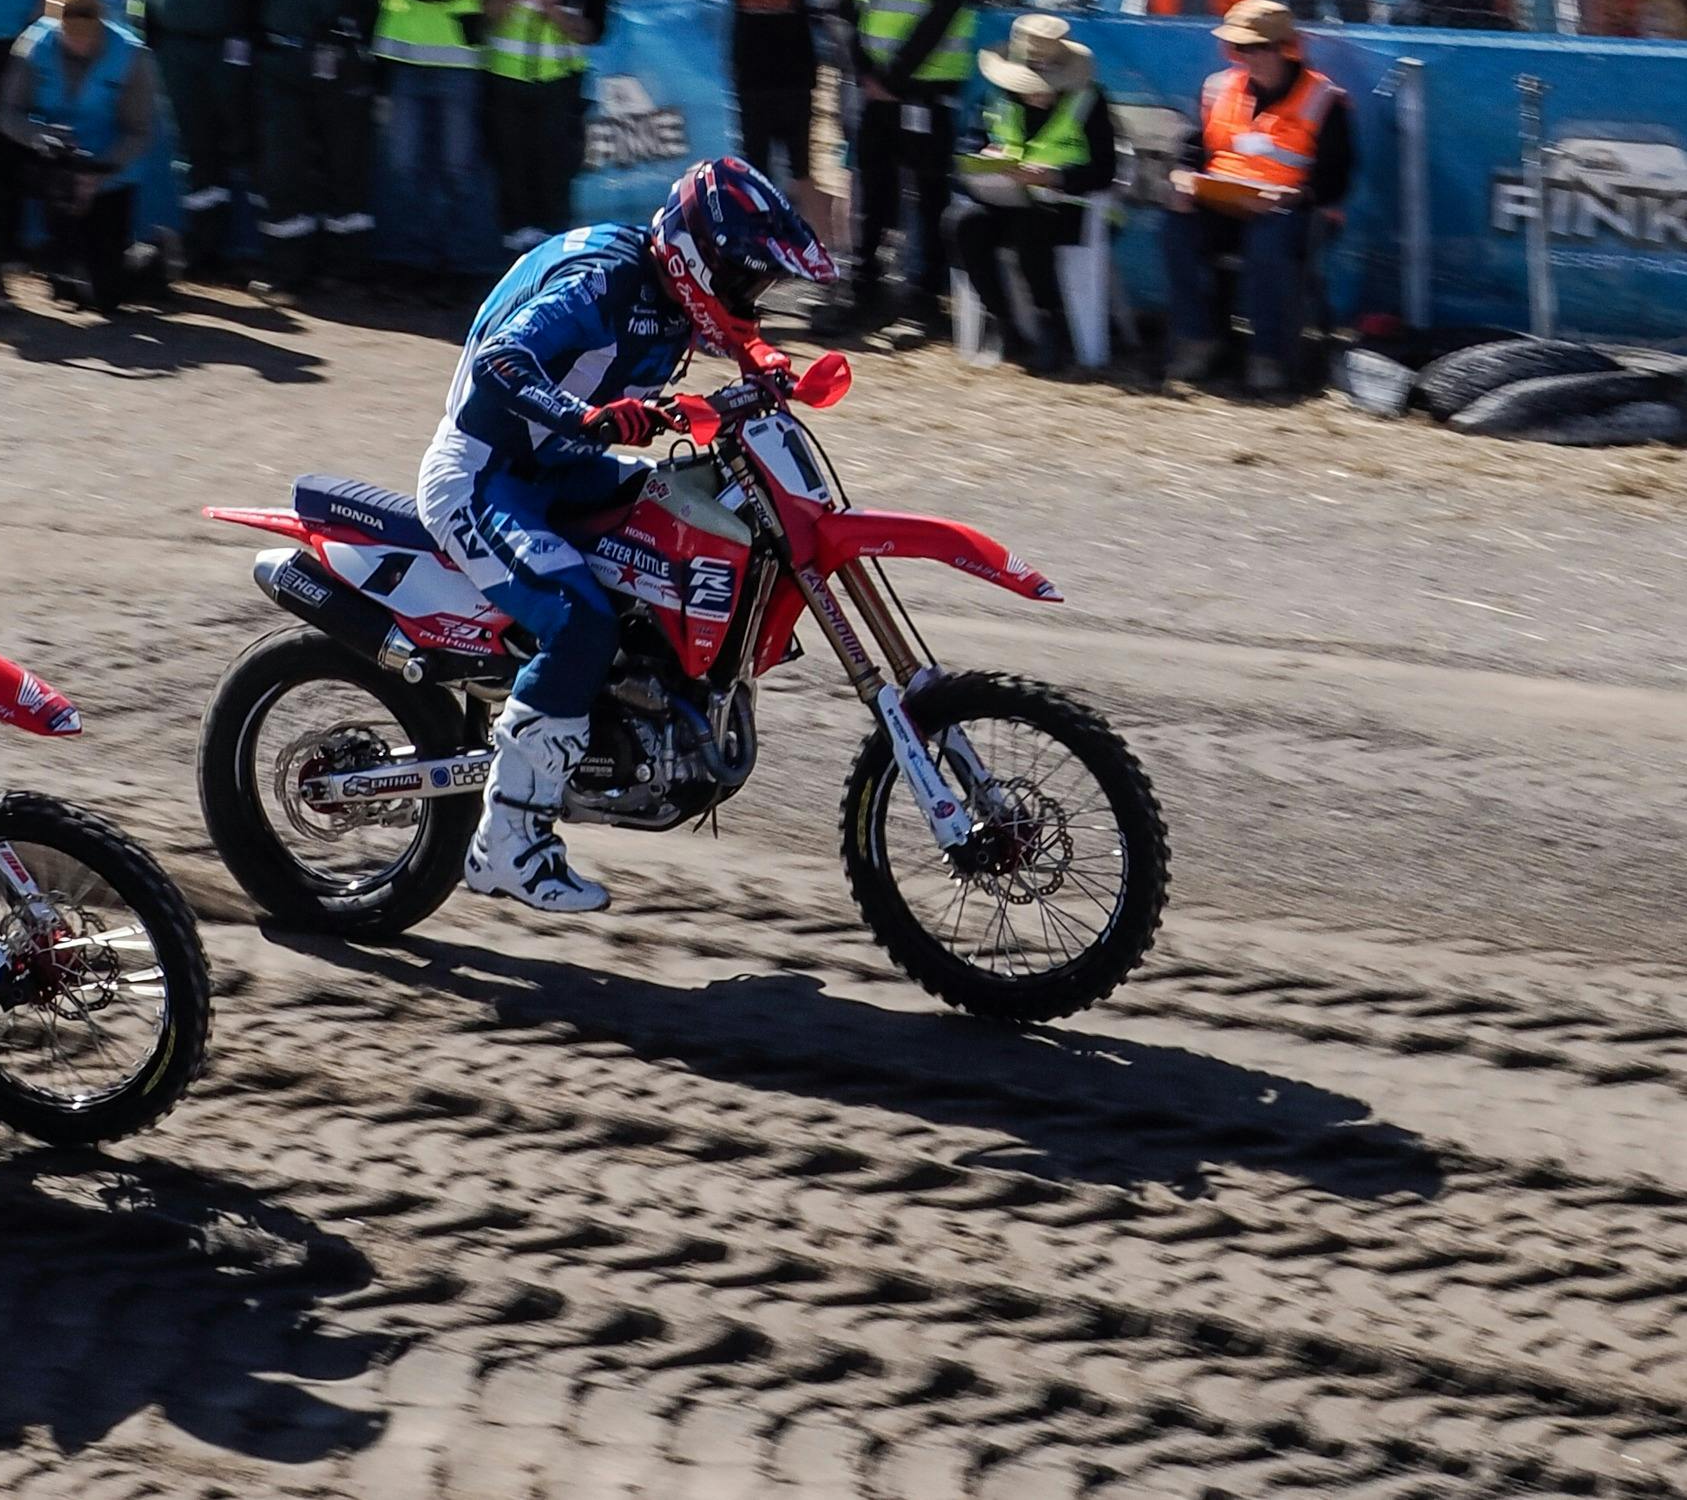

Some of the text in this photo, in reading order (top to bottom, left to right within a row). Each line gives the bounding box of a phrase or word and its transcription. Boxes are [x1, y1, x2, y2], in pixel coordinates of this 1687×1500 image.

[783, 429, 823, 492] 1
[330, 502, 384, 531] HONDA
[625, 526, 656, 547] HONDA
[360, 550, 419, 597] 1
[596, 537, 670, 578] PETER KITTLE
[690, 555, 733, 605] CRF
[452, 760, 490, 776] QUAD
[453, 774, 490, 787] LOC
